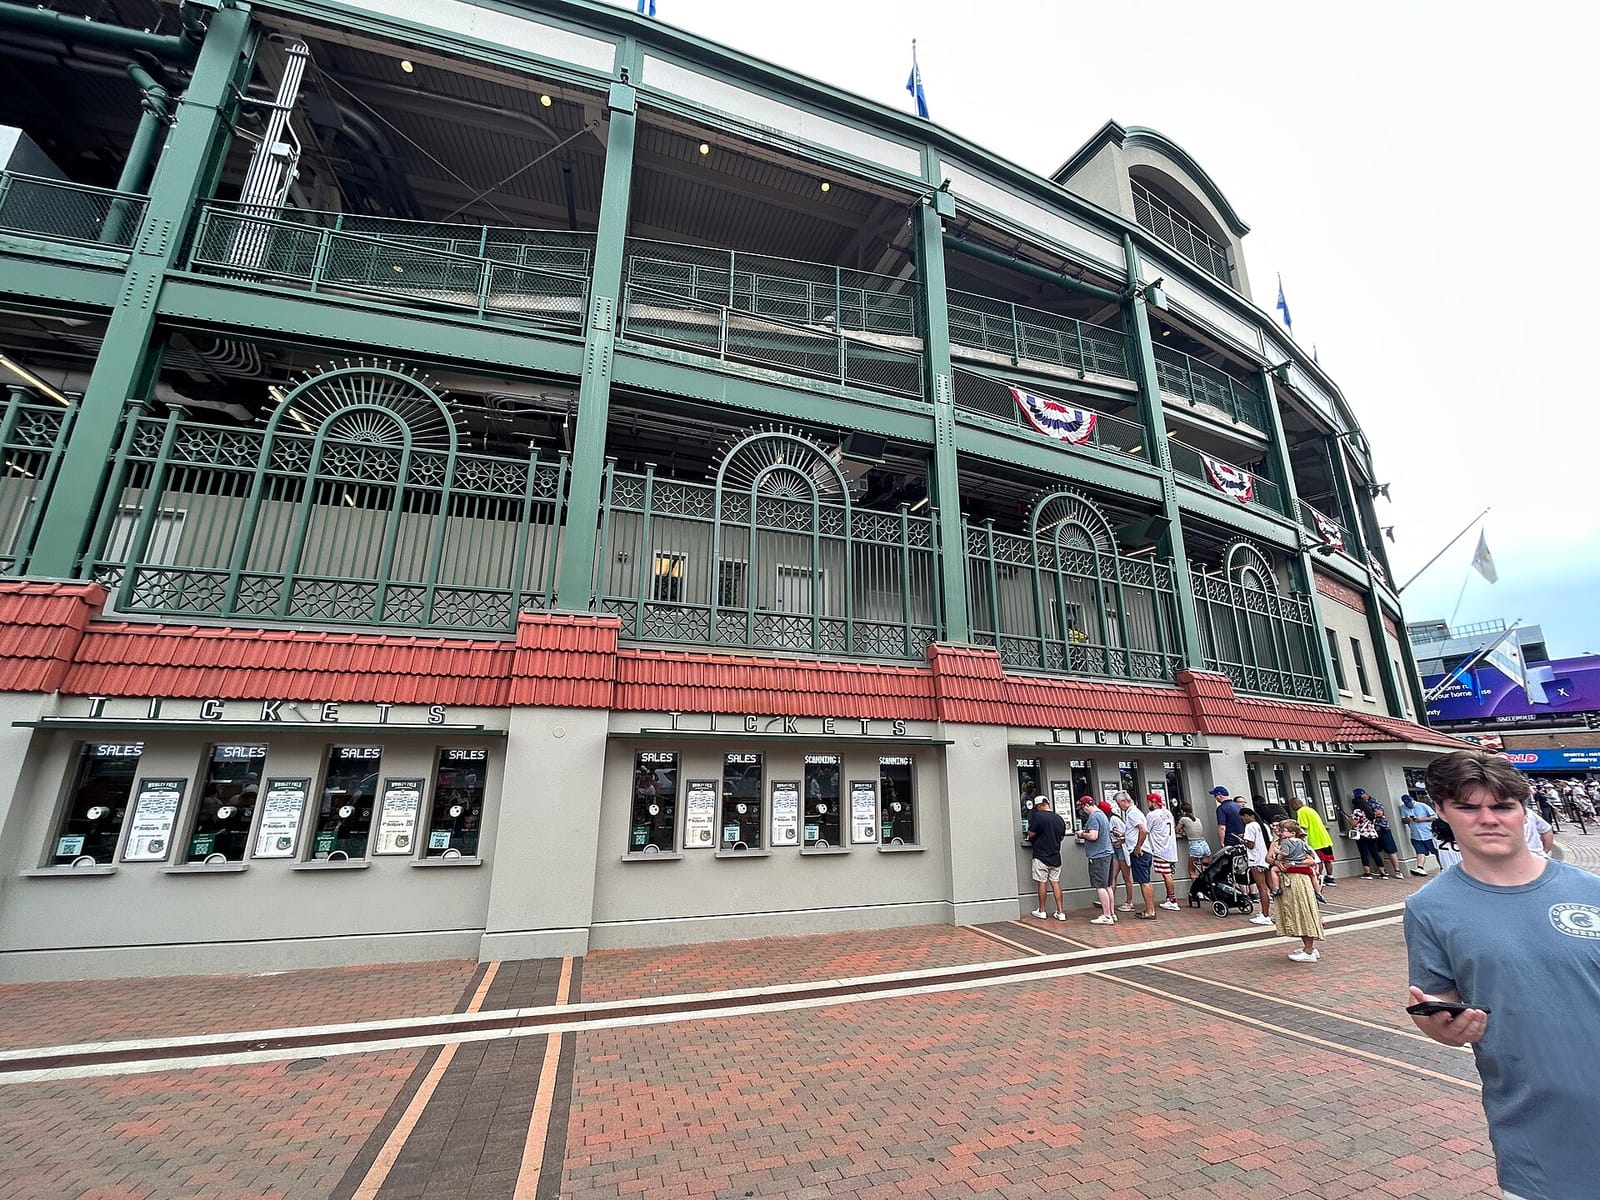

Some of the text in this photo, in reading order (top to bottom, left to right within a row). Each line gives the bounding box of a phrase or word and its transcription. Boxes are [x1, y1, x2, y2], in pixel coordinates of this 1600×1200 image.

[1451, 691, 1473, 699] home
[87, 696, 447, 724] TICKETS
[668, 712, 907, 736] TICKETS
[1052, 728, 1194, 746] TICKETS
[96, 744, 144, 756] SALES
[1273, 738, 1356, 753] TICKETS
[223, 747, 267, 758] SALES
[340, 748, 381, 759] SALES
[448, 750, 486, 760] SALES
[641, 752, 673, 763] SALES
[1503, 752, 1538, 763] RLD
[727, 754, 757, 764] SALES
